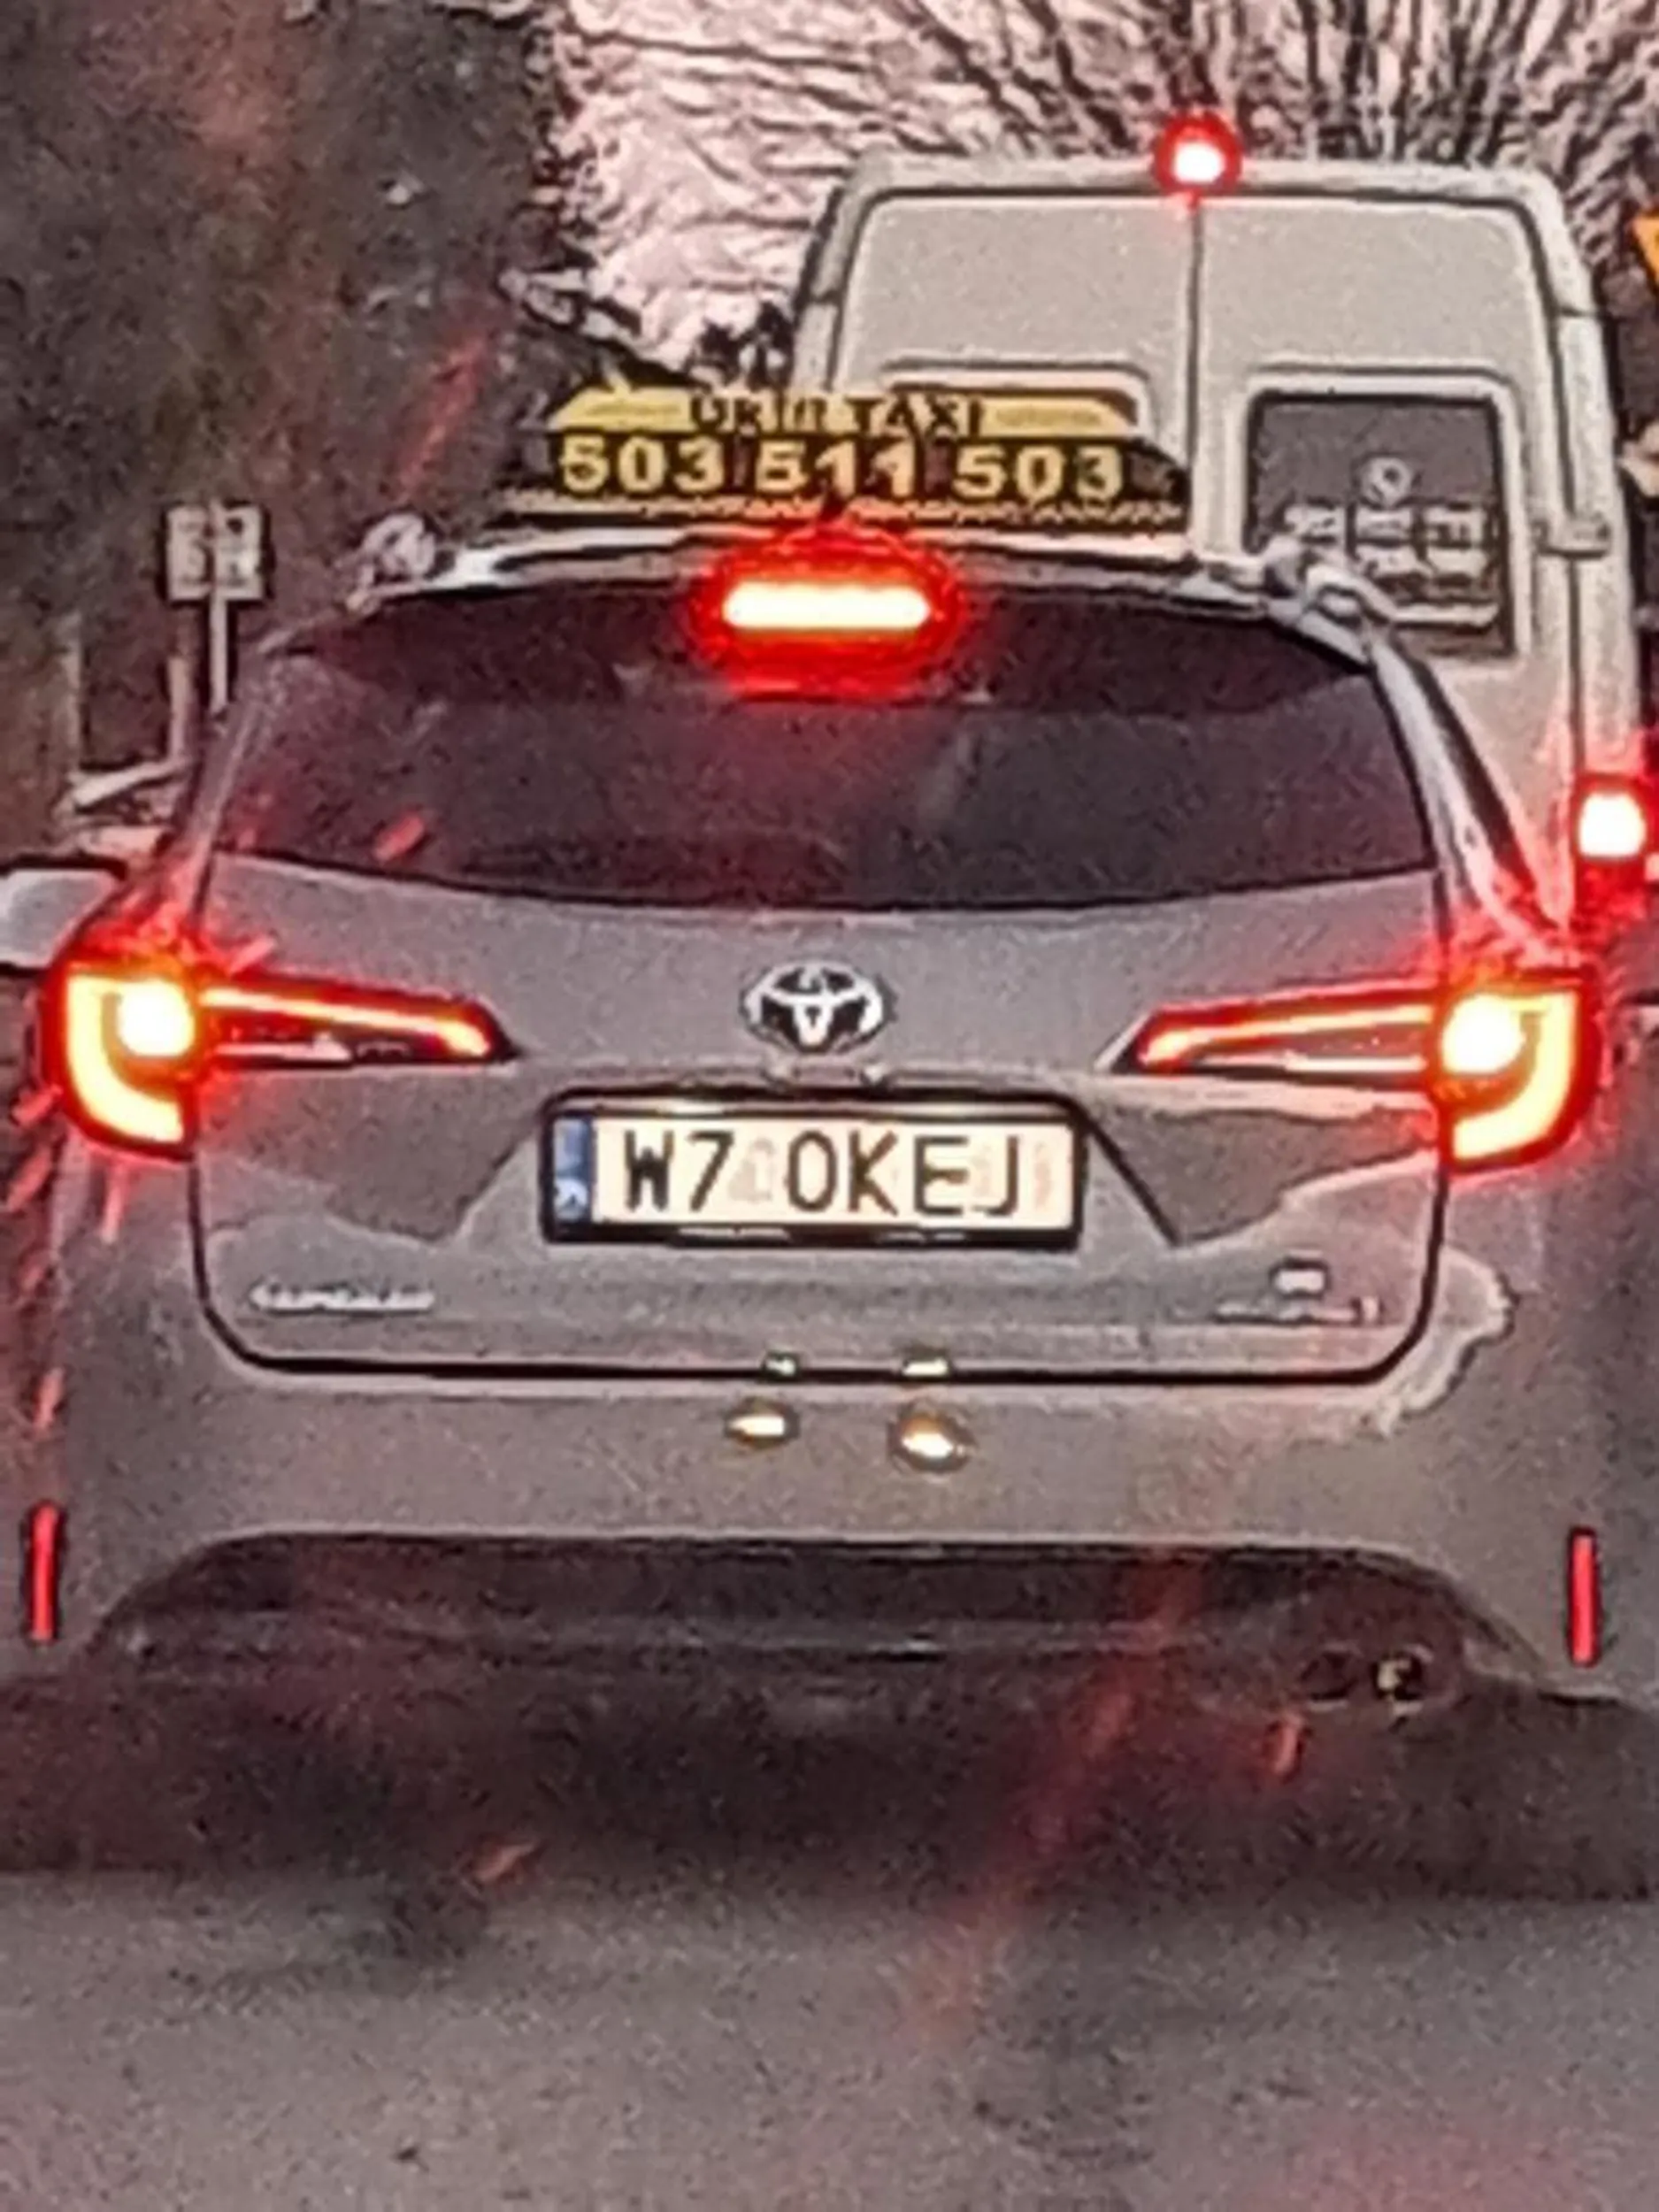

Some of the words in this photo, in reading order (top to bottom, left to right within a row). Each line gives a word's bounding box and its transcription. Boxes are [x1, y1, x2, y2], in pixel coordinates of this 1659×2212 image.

[843, 397, 984, 435] TAXI
[560, 434, 725, 495] 503
[757, 437, 915, 497] 511
[952, 443, 1123, 503] 503
[624, 1129, 733, 1211] W7
[786, 1131, 1018, 1216] OKEJ
